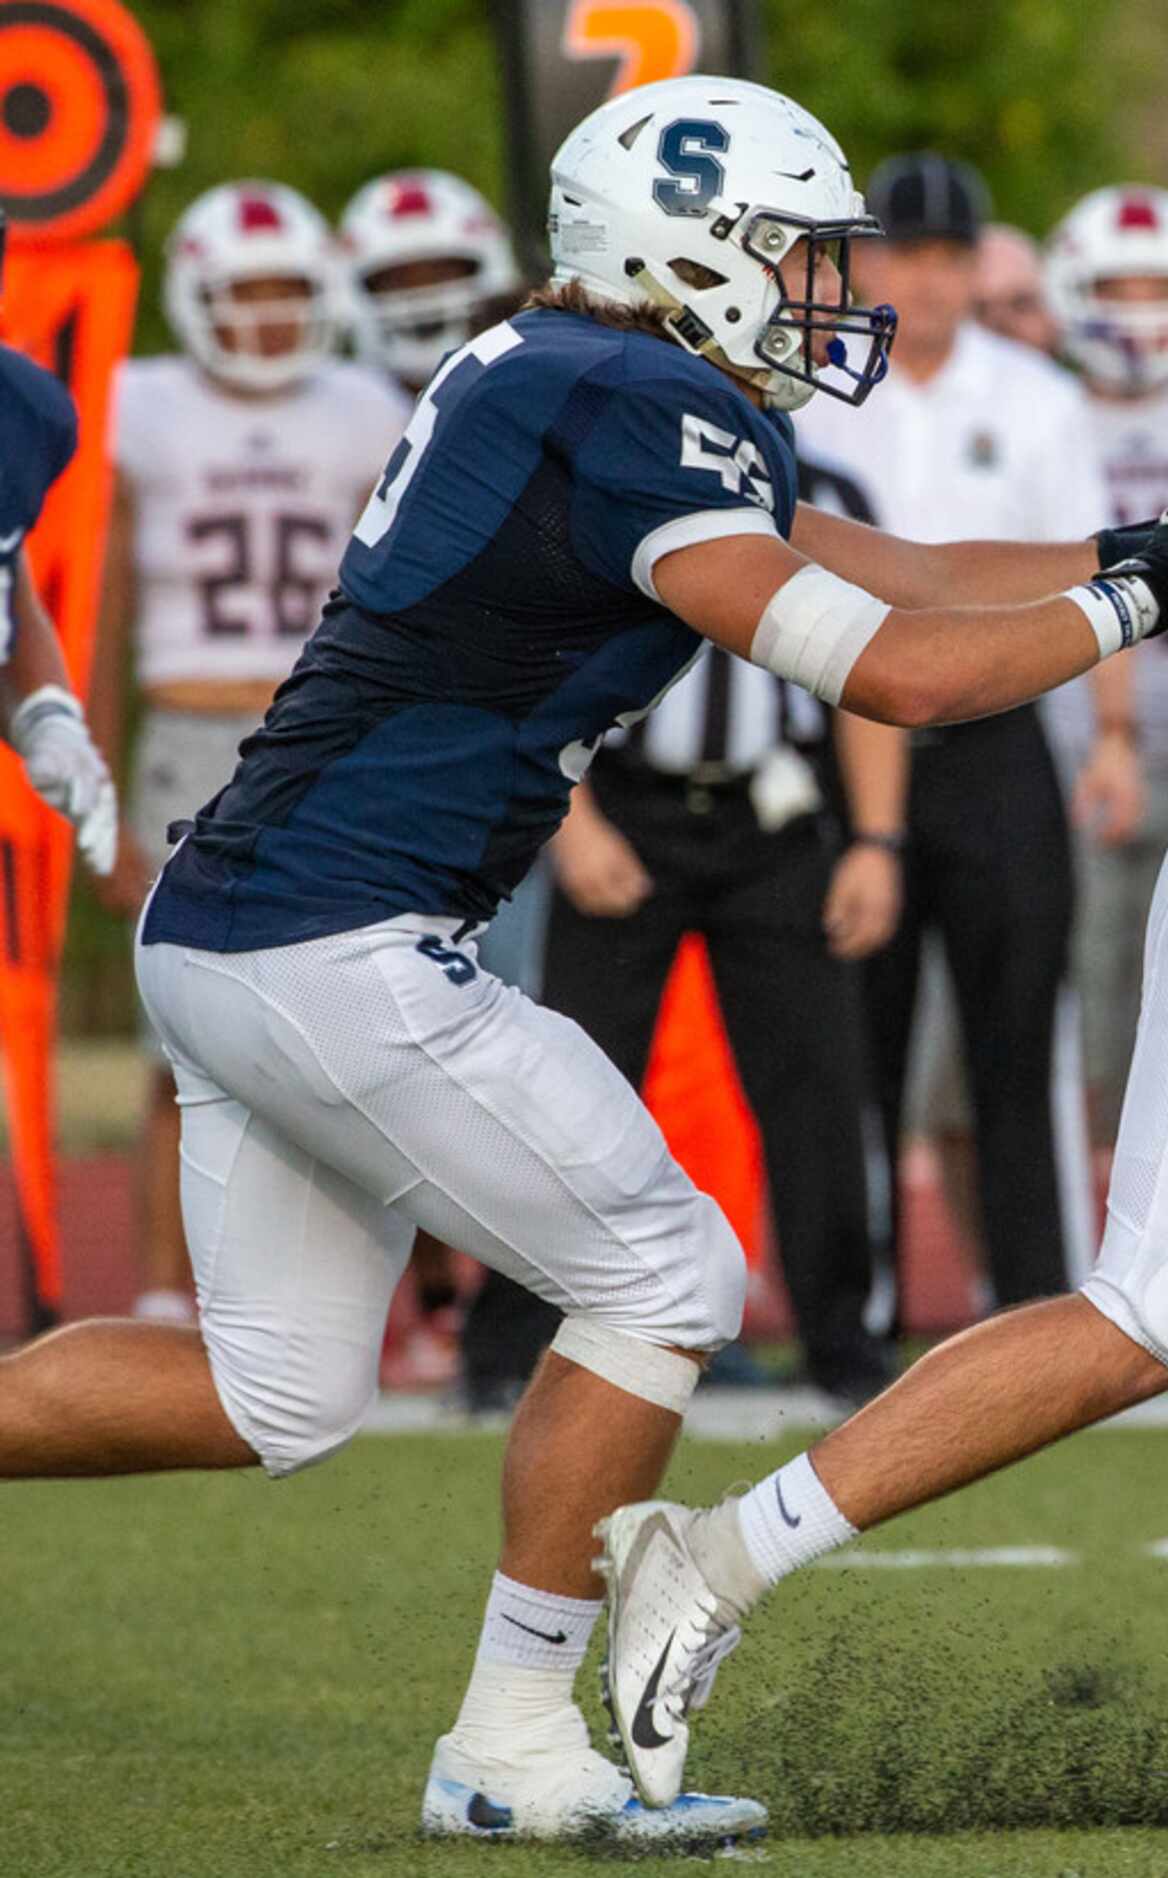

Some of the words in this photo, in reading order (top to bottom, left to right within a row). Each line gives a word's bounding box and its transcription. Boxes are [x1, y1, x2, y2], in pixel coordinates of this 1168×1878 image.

[652, 118, 731, 217] S
[188, 513, 333, 637] 26
[415, 933, 478, 987] S
